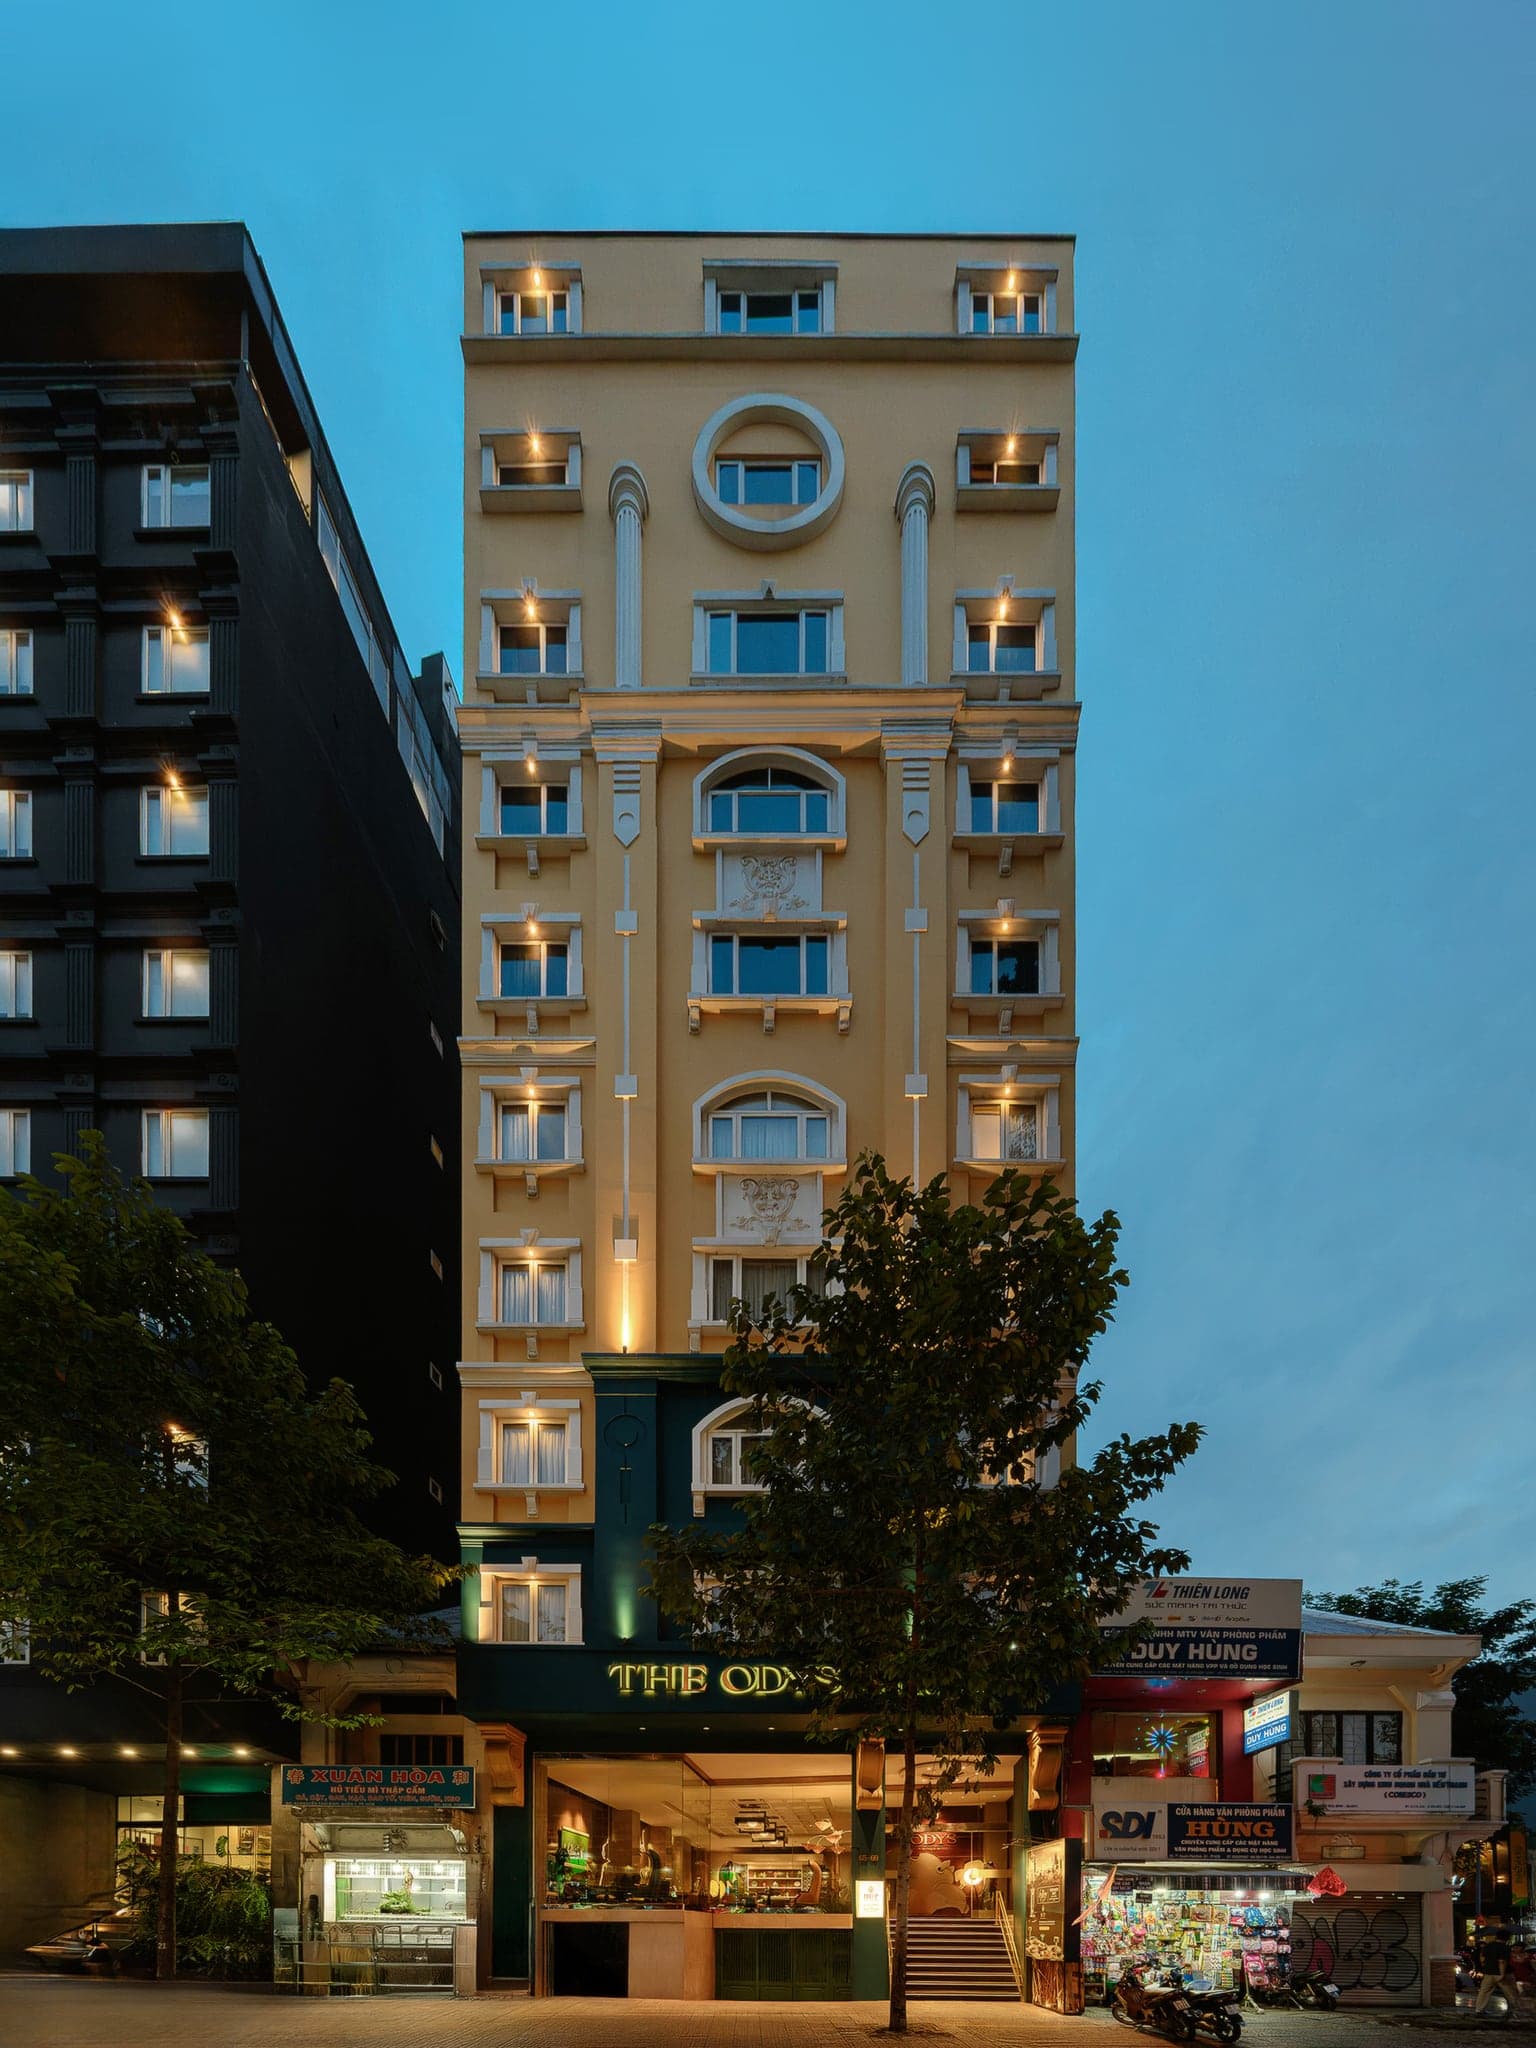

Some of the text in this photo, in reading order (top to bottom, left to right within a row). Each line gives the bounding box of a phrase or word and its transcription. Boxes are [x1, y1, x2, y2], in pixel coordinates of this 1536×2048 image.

[1173, 1583, 1250, 1600] THIÊN LONG
[1151, 1630, 1174, 1638] NHH
[1177, 1630, 1198, 1638] MTV
[1223, 1629, 1256, 1639] PHÒNG
[1258, 1629, 1287, 1640] PHẨM
[1131, 1638, 1258, 1661] DUY HÙNG
[608, 1663, 709, 1693] THE
[1247, 1733, 1262, 1745] DUY
[1264, 1723, 1287, 1738] HÙNG
[311, 1767, 445, 1783] XUÂN HÒA
[345, 1784, 365, 1794] TIẾU
[1175, 1804, 1286, 1817] CỬA HÀNG VĂN PHÒNG PHẨM
[1101, 1811, 1156, 1839] SDI
[1185, 1816, 1276, 1837] HÙNG
[911, 1833, 957, 1845] ODYS
